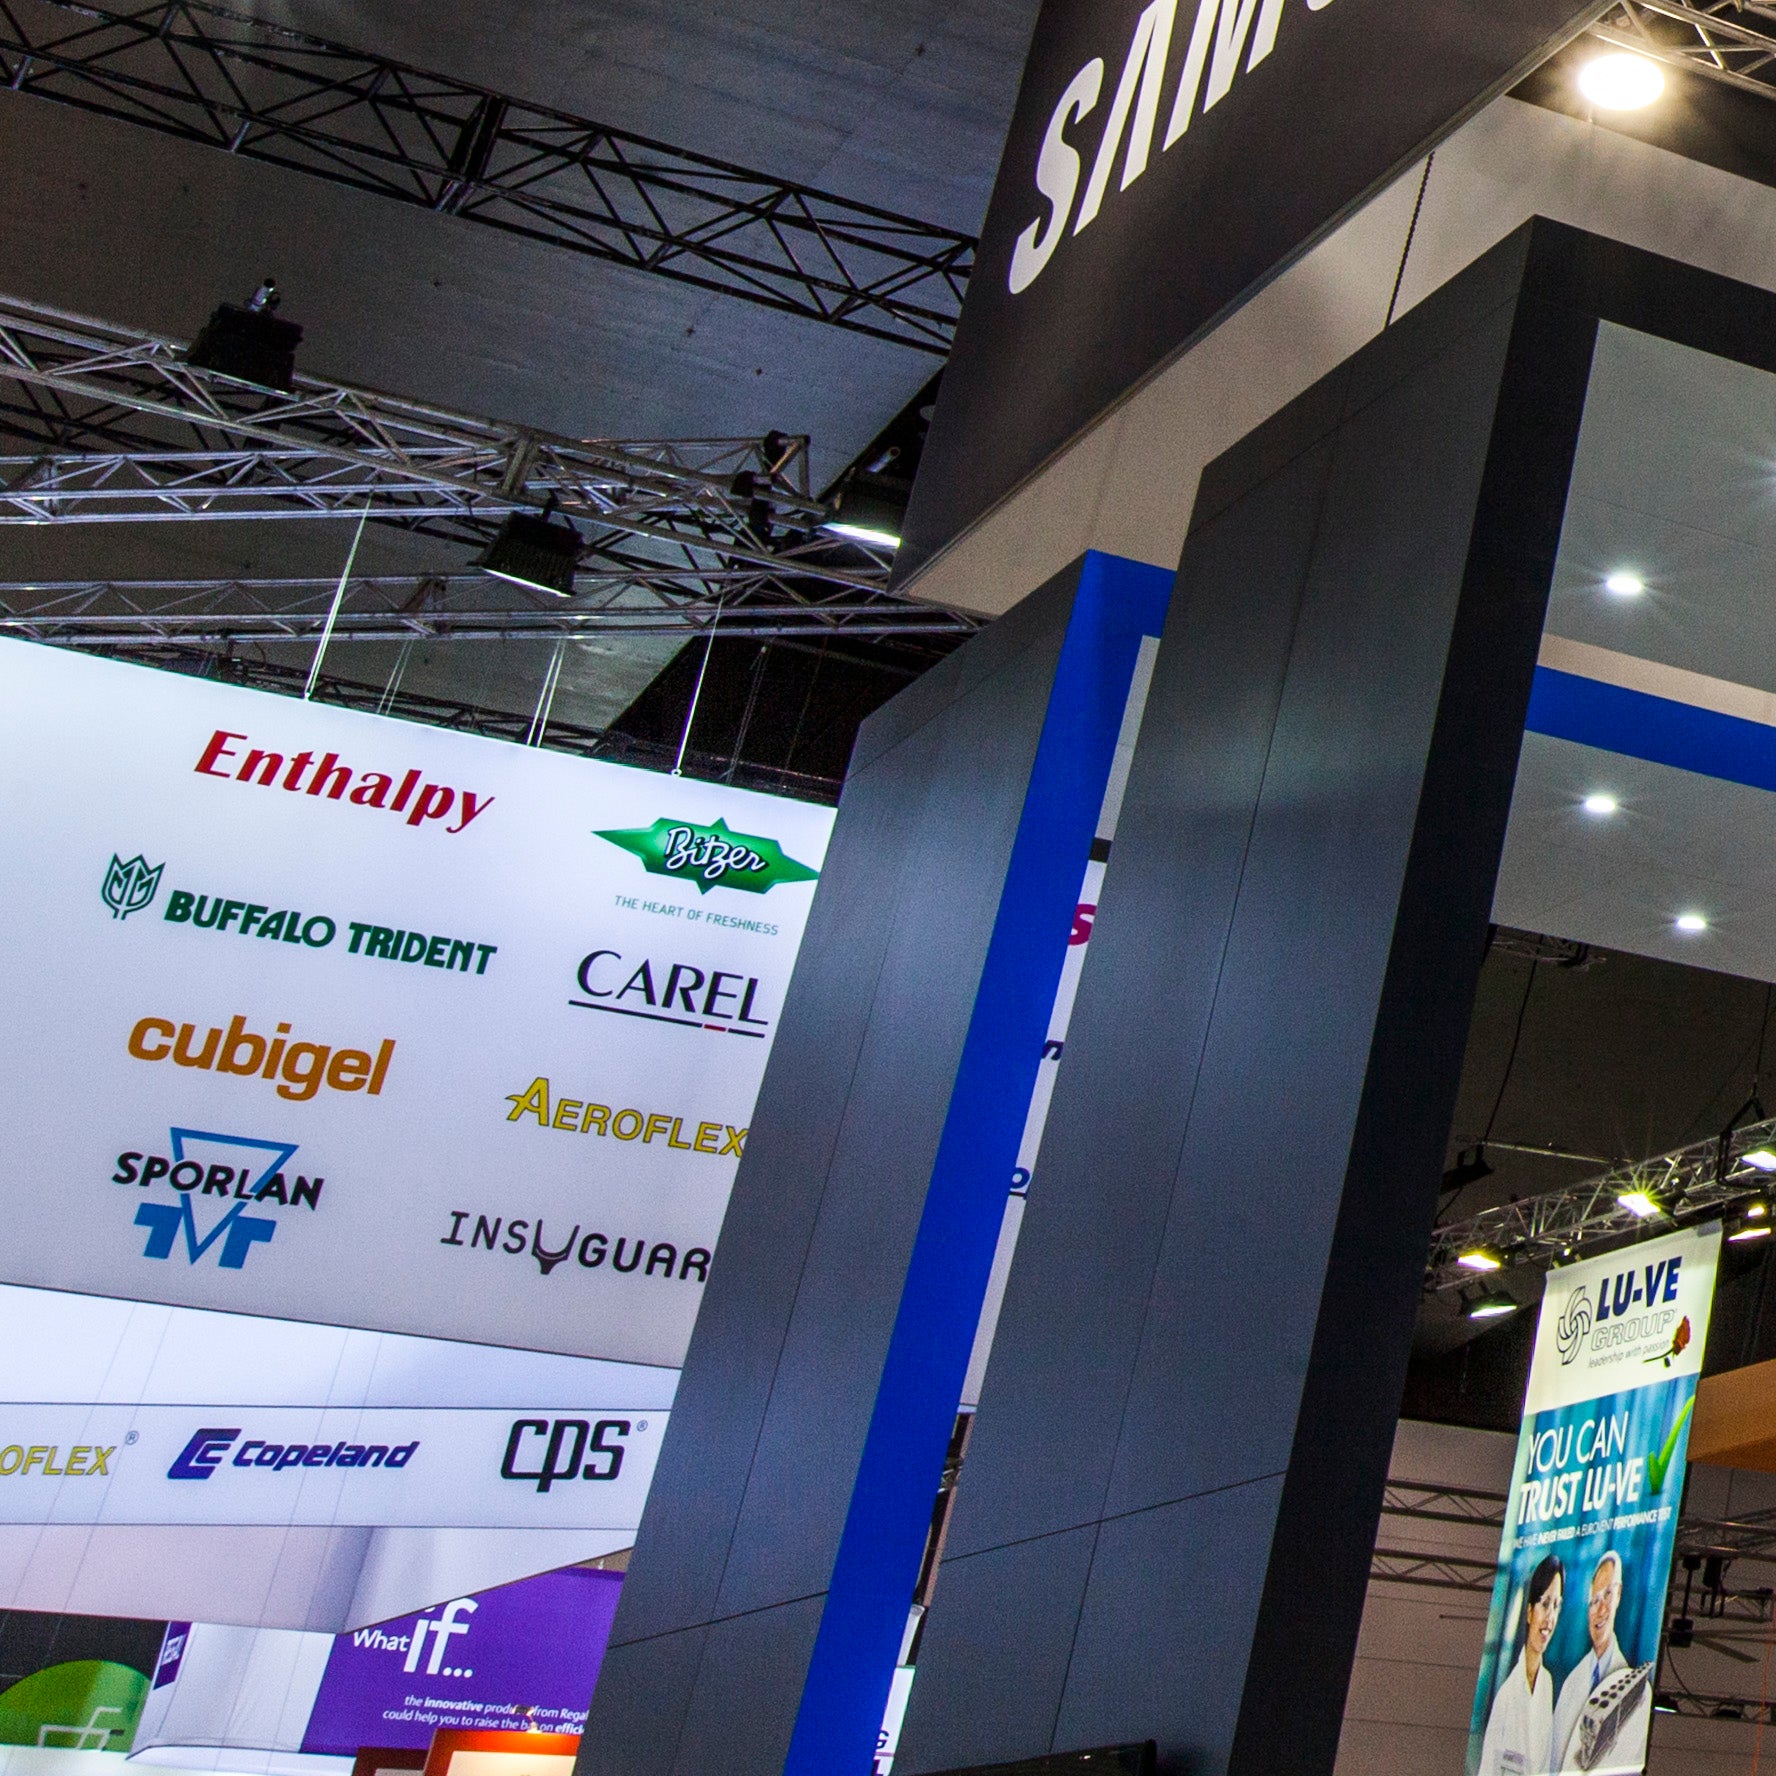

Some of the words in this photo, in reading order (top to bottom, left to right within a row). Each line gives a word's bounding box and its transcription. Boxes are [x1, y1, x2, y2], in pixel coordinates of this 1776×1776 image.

[194, 730, 495, 833] Enthalpy
[164, 889, 336, 948] BUFFALO
[347, 922, 498, 975] TRIDENT
[615, 895, 638, 910] THE
[643, 900, 684, 918] HEART
[687, 909, 703, 921] OF
[706, 912, 779, 936] FRESHNESS
[577, 949, 768, 1026] CAREL
[127, 1014, 396, 1102] cubigel
[112, 1151, 325, 1211] SPORLAN
[1596, 1256, 1682, 1321] LU-VE
[1591, 1309, 1675, 1351] GROUP
[232, 1440, 420, 1471] Copeland
[1528, 1425, 1574, 1475] YOU
[1576, 1411, 1629, 1463] CAN
[1518, 1471, 1583, 1525] TRUST
[1582, 1457, 1644, 1512] LU-VE
[353, 1629, 410, 1652] What
[383, 1708, 413, 1721] could
[414, 1711, 438, 1726] help
[440, 1716, 460, 1726] you
[461, 1715, 472, 1726] to
[474, 1715, 499, 1728] raise
[501, 1717, 520, 1729] the
[405, 1695, 423, 1707] the
[424, 1697, 483, 1712] innovative
